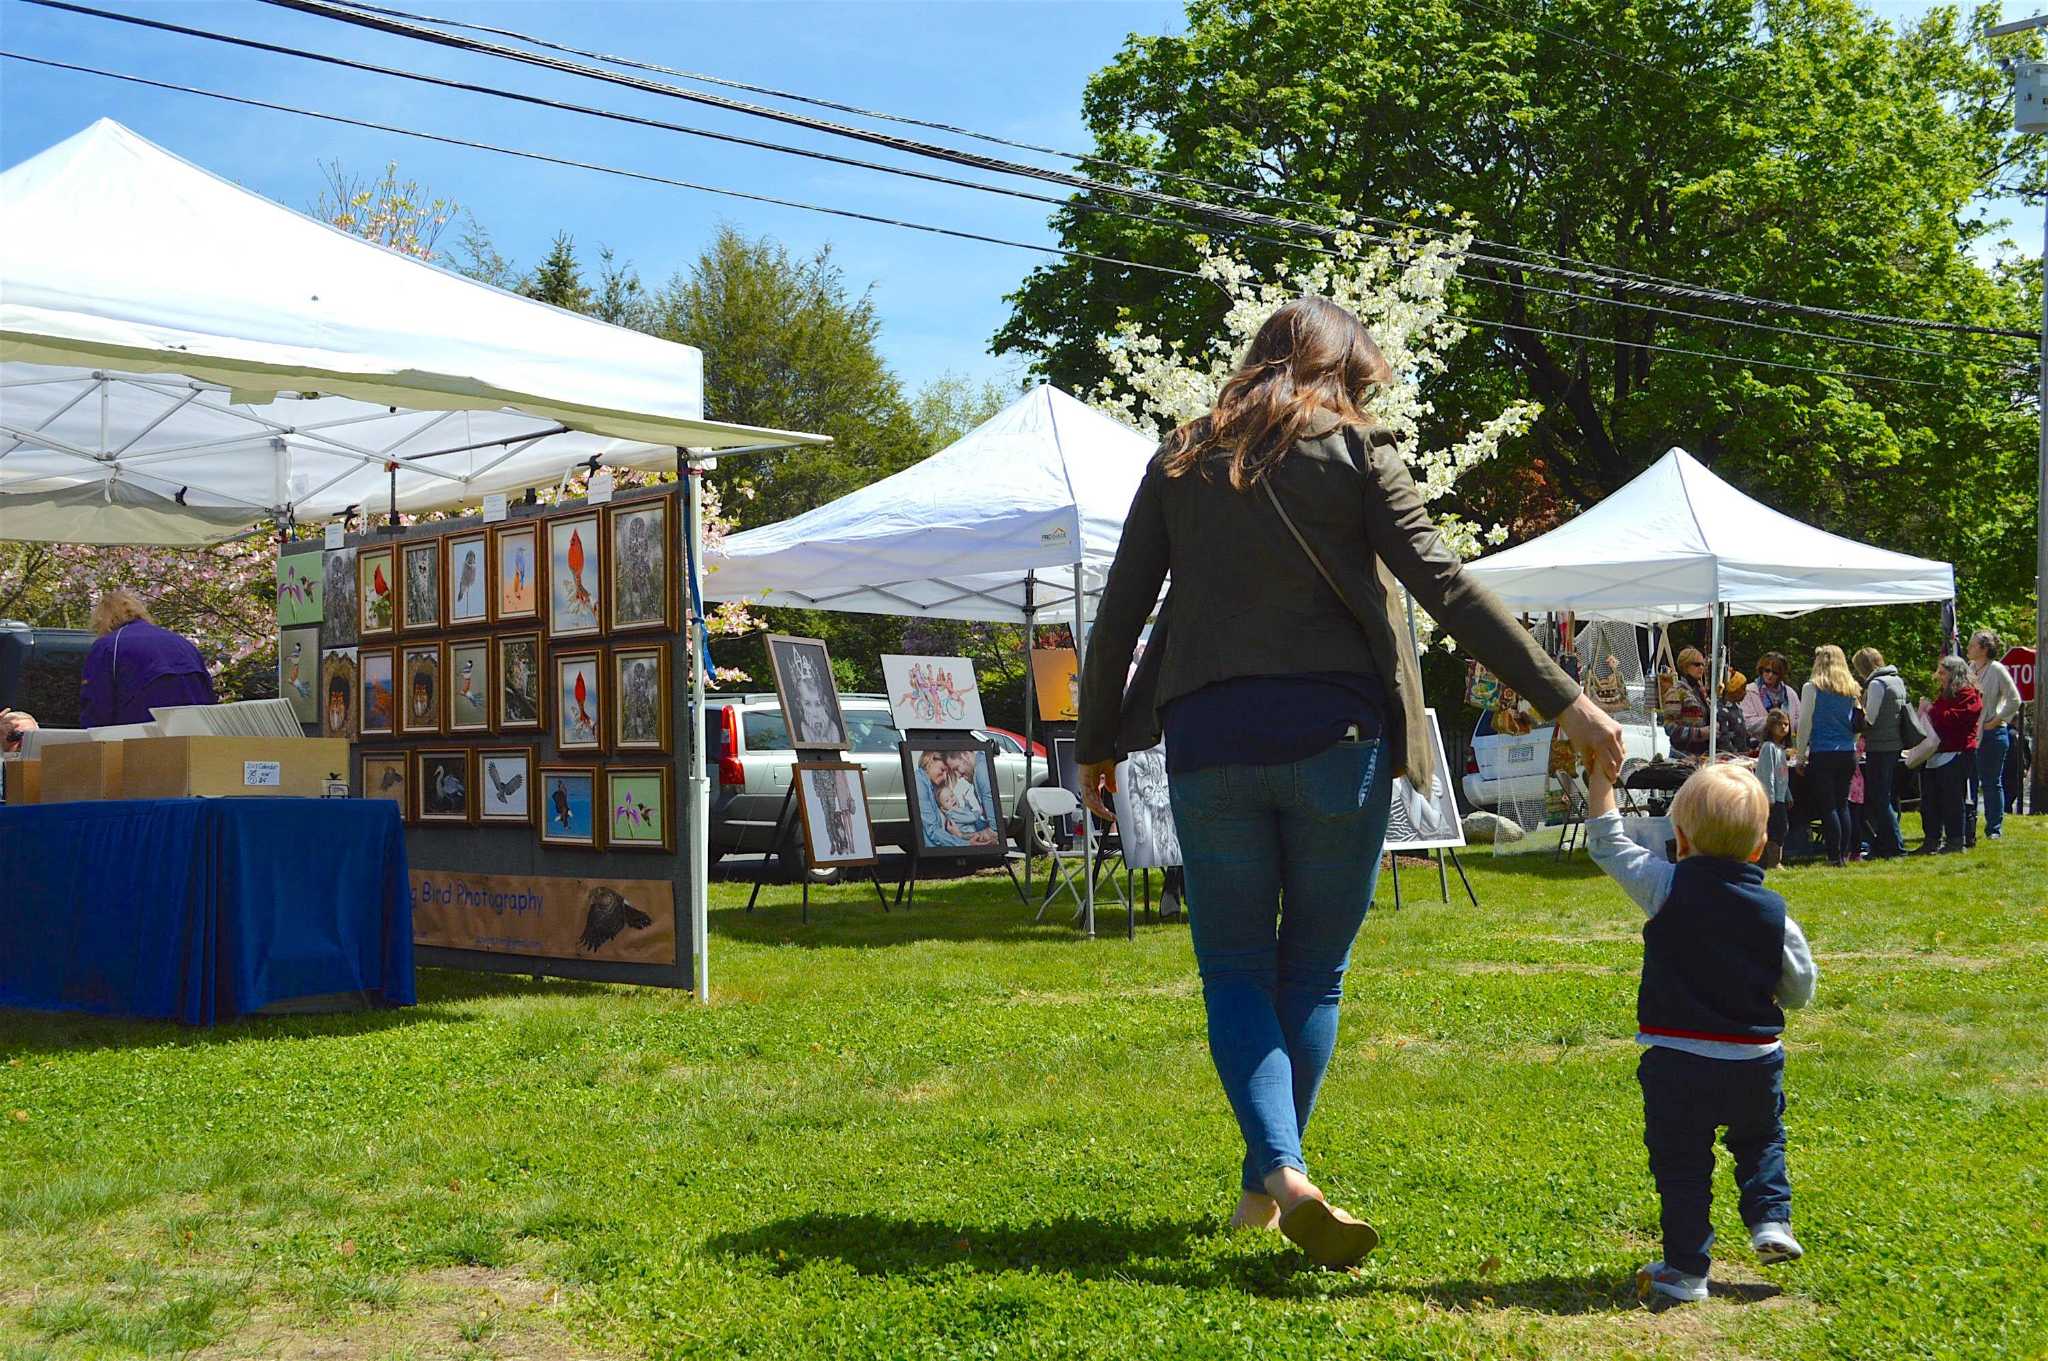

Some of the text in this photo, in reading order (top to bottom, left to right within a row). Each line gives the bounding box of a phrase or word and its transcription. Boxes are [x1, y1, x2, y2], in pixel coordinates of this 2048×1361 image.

[2005, 664, 2036, 685] TO
[422, 879, 451, 906] Bird
[456, 882, 544, 918] Photography
